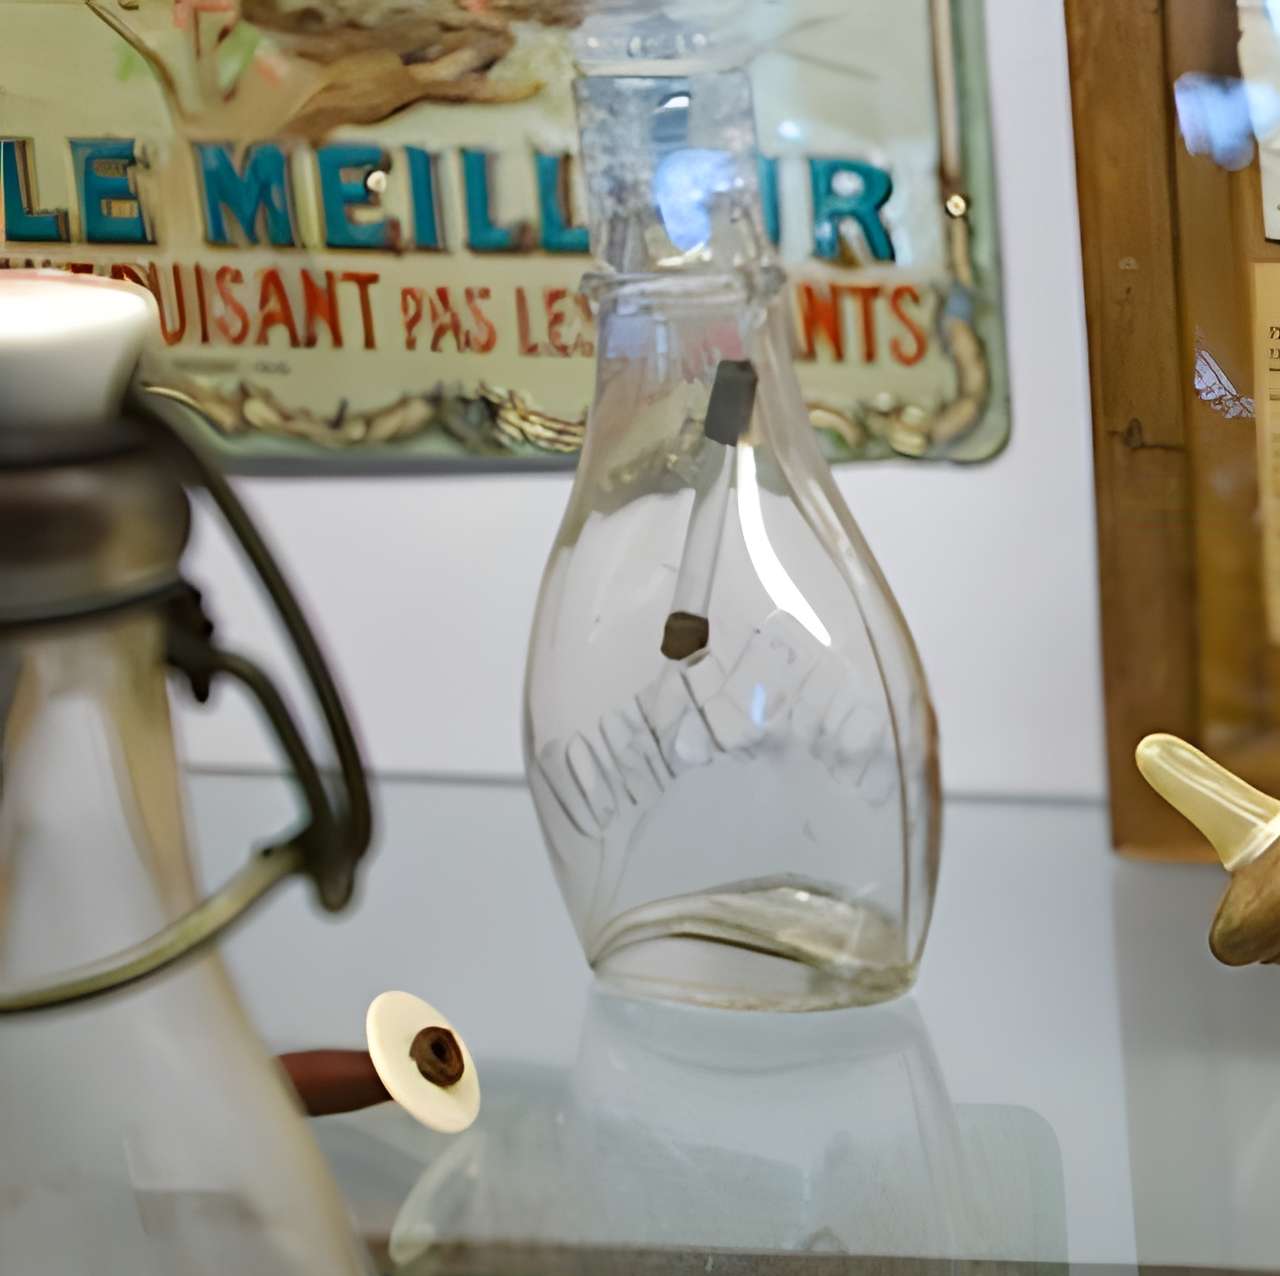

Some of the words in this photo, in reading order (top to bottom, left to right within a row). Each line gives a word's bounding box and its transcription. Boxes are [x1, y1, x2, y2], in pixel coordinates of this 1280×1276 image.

[1, 137, 154, 246] LE
[195, 142, 897, 263] MEILLR
[401, 286, 497, 352] PAS
